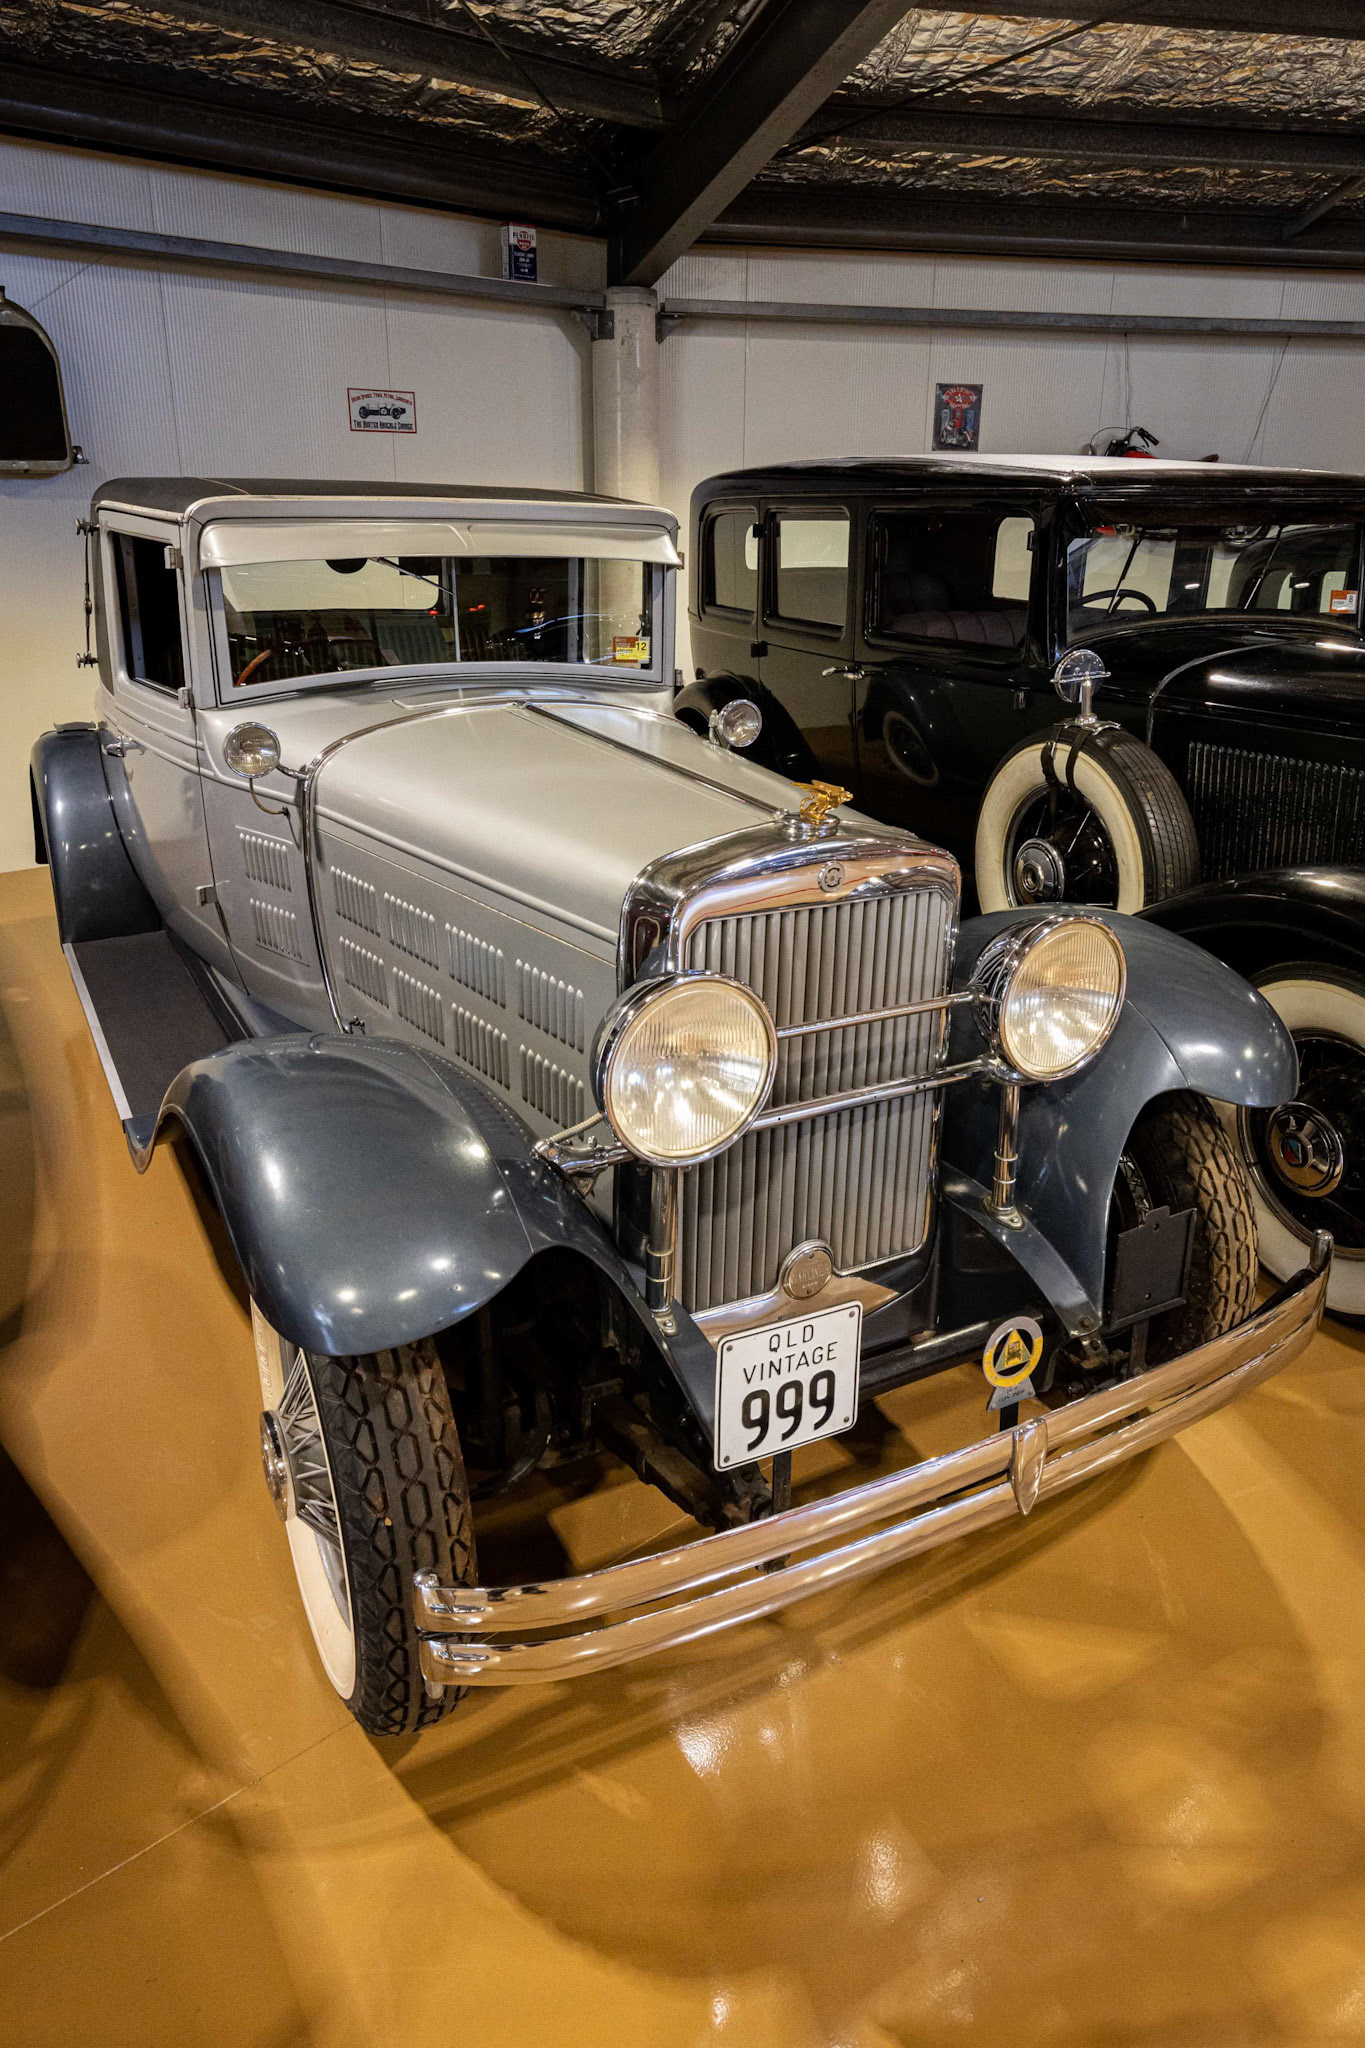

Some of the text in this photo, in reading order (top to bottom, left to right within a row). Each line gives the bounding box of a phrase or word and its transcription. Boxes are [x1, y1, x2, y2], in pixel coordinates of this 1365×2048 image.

[636, 642, 646, 650] 12
[768, 1324, 815, 1353] QLD
[743, 1341, 838, 1385] VINTAGE
[741, 1369, 836, 1452] 999
